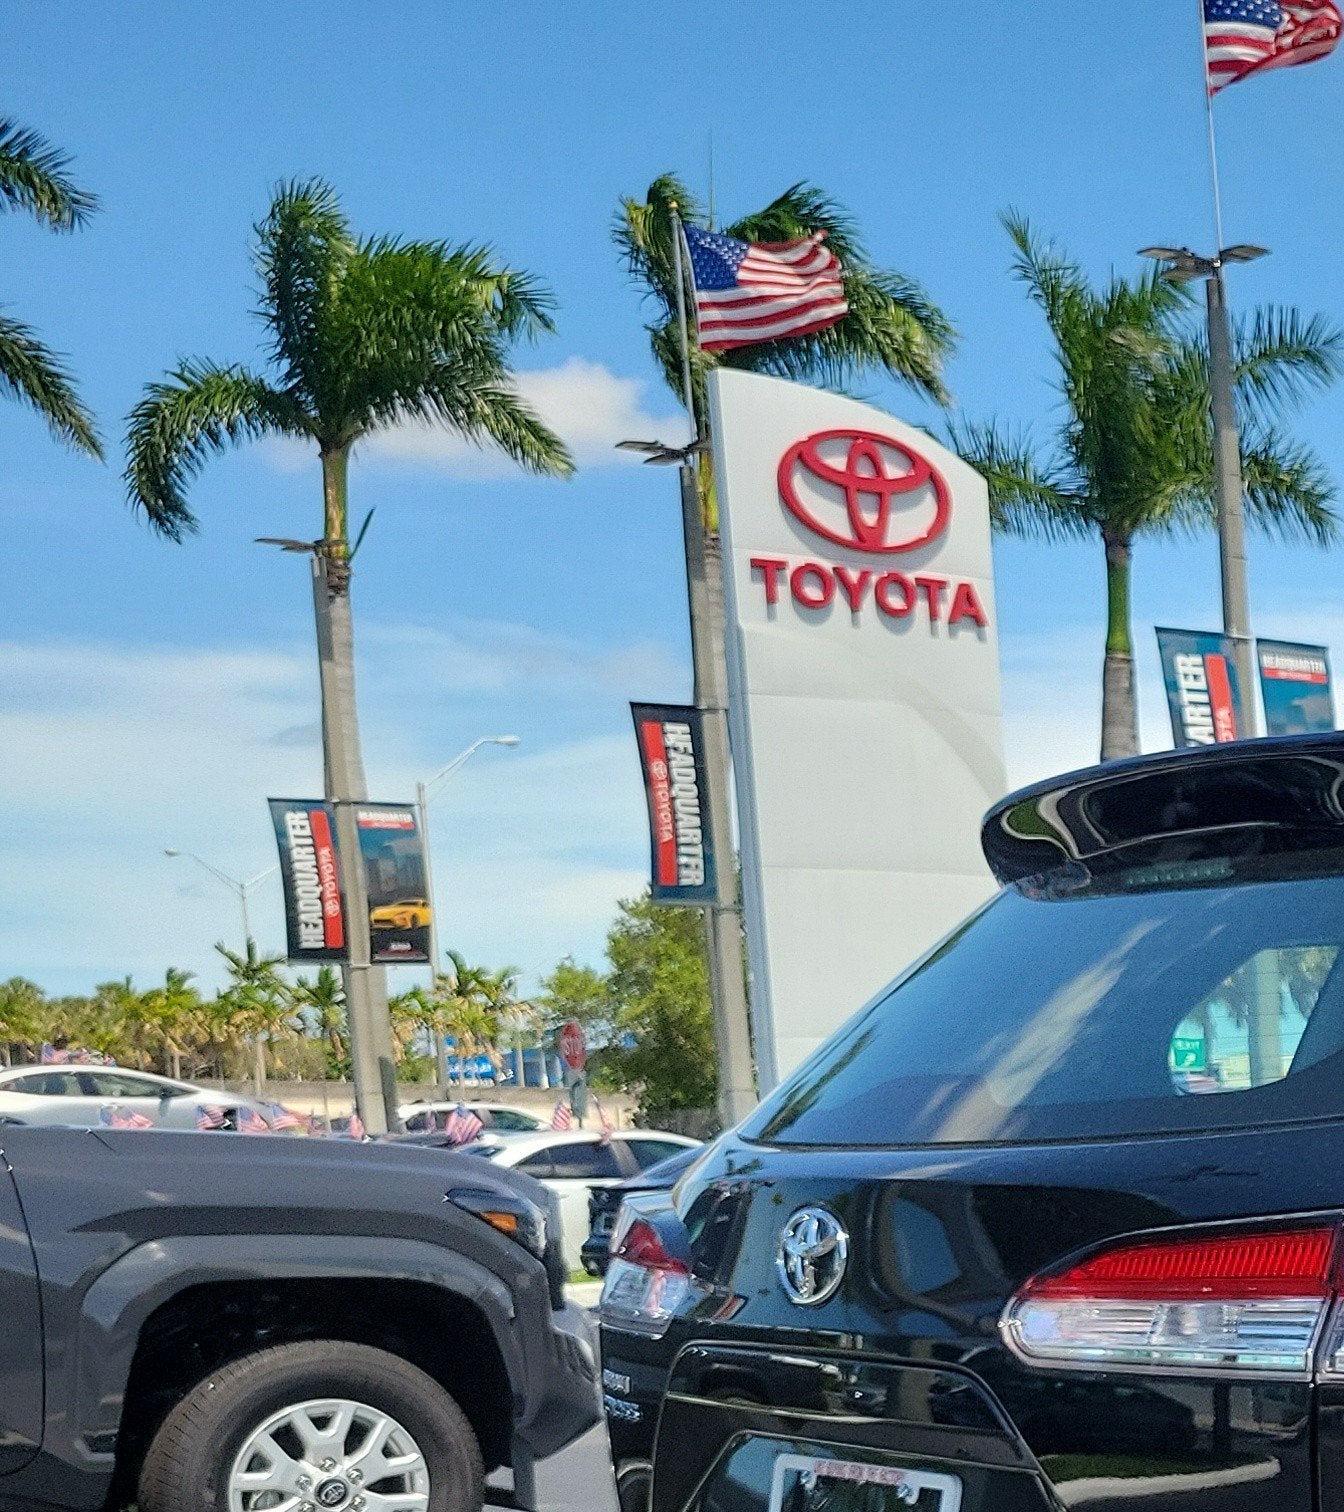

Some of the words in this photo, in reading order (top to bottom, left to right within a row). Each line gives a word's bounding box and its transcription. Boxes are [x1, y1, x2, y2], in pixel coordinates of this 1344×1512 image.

[750, 558, 988, 628] TOYOTA
[1175, 654, 1216, 747] ARTER
[655, 780, 673, 843] TOYOTA
[663, 721, 705, 887] HEADQUARTER
[285, 811, 325, 949] HEADQUARTER
[319, 846, 340, 900] TOYOTA
